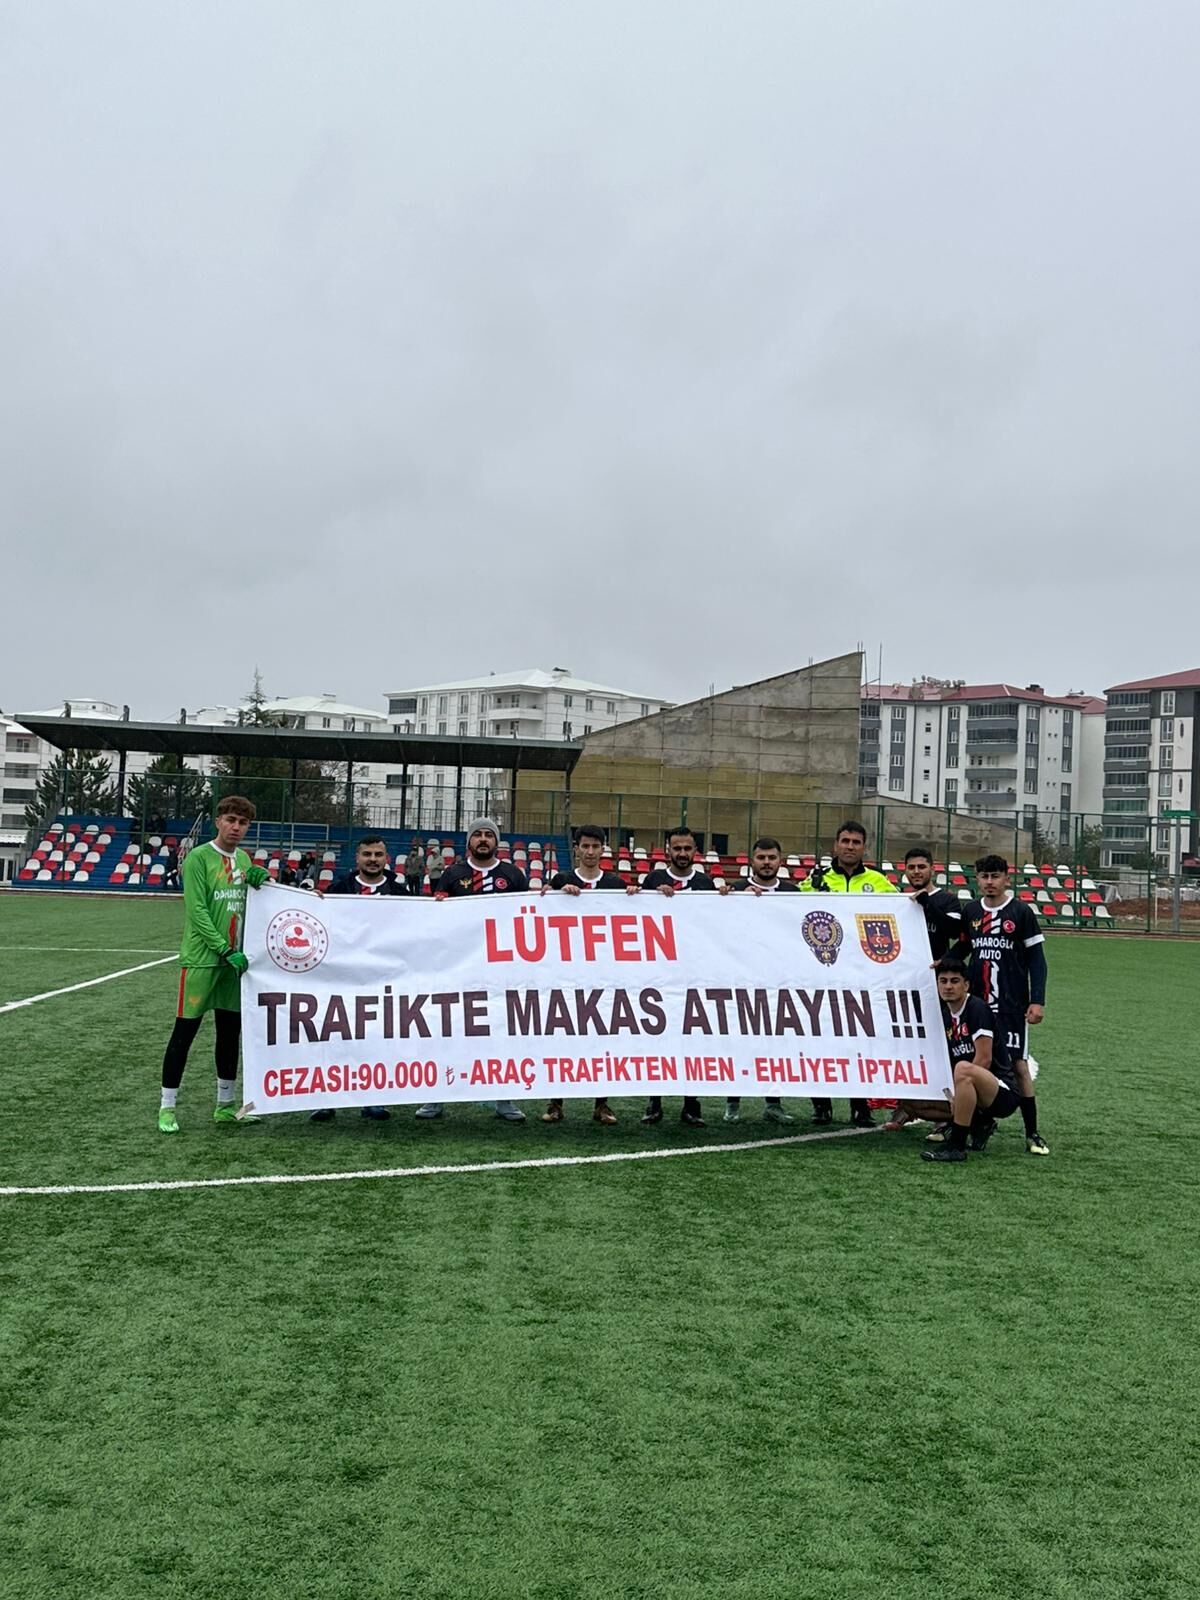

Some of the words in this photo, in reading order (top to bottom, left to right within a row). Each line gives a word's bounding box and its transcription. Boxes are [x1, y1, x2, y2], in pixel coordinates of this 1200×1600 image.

[226, 901, 244, 912] AUTO
[485, 906, 677, 963] LÜTFEN
[979, 949, 1002, 960] AUTO
[258, 986, 490, 1046] TRAFİKTE
[505, 988, 667, 1036] MAKAS
[682, 989, 876, 1037] ATMAYIN
[886, 990, 926, 1039] !!!
[1006, 1031, 1021, 1049] 11
[263, 1060, 438, 1098] CEZASI:90.000
[543, 1051, 678, 1083] TRAFİKTEN
[685, 1056, 735, 1082] MEN
[755, 1051, 850, 1083] EHLİYET
[857, 1052, 928, 1085] İPTALİ
